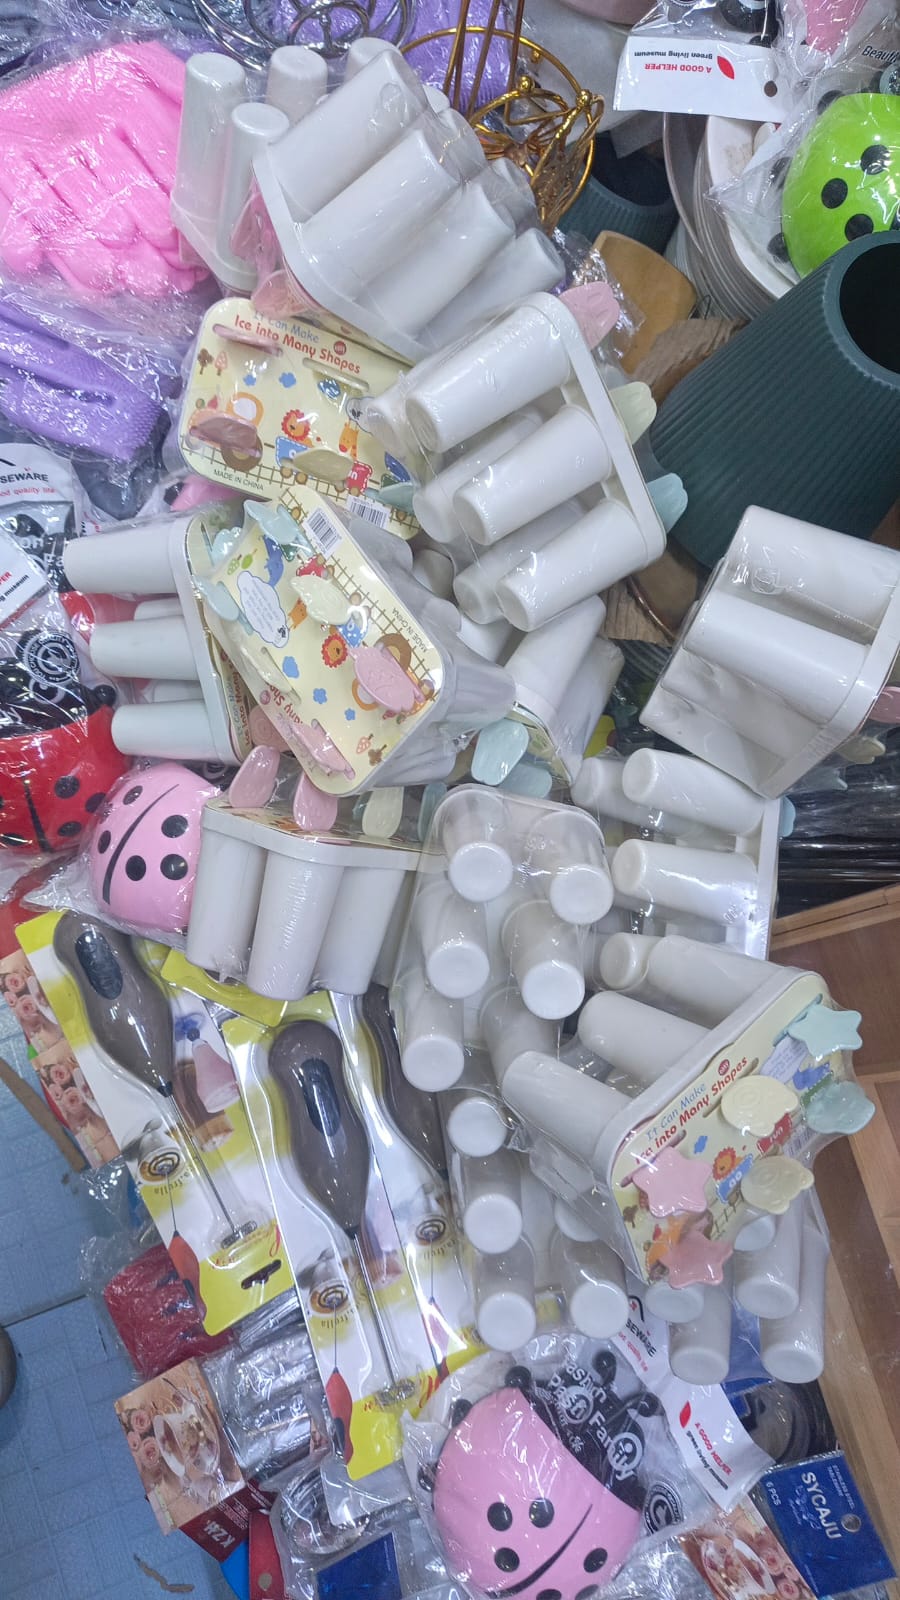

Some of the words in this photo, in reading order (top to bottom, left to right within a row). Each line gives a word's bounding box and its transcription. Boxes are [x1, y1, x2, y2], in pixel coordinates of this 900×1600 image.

[668, 50, 690, 59] living
[691, 52, 713, 60] green
[644, 63, 678, 71] HELPER
[680, 64, 704, 72] GOOD
[234, 315, 252, 331] Ice
[255, 323, 279, 341] into
[282, 334, 316, 358] Many
[319, 349, 360, 374] Shapes
[290, 326, 320, 343] Make
[0, 473, 49, 484] SEWARE
[213, 468, 234, 482] MADE
[234, 475, 243, 485] IN
[242, 477, 265, 492] CHINA
[392, 607, 409, 628] CHINA
[411, 633, 428, 653] MADE
[239, 706, 248, 728] into
[646, 1127, 658, 1141] It
[660, 1109, 679, 1128] Can
[680, 1083, 706, 1110] Make
[654, 1125, 677, 1148] into
[679, 1094, 709, 1126] Many
[711, 1057, 748, 1096] Shapes
[686, 1430, 699, 1449] green
[699, 1428, 713, 1451] GOOD
[768, 1487, 782, 1506] PCS
[801, 1471, 843, 1539] SYCAJU
